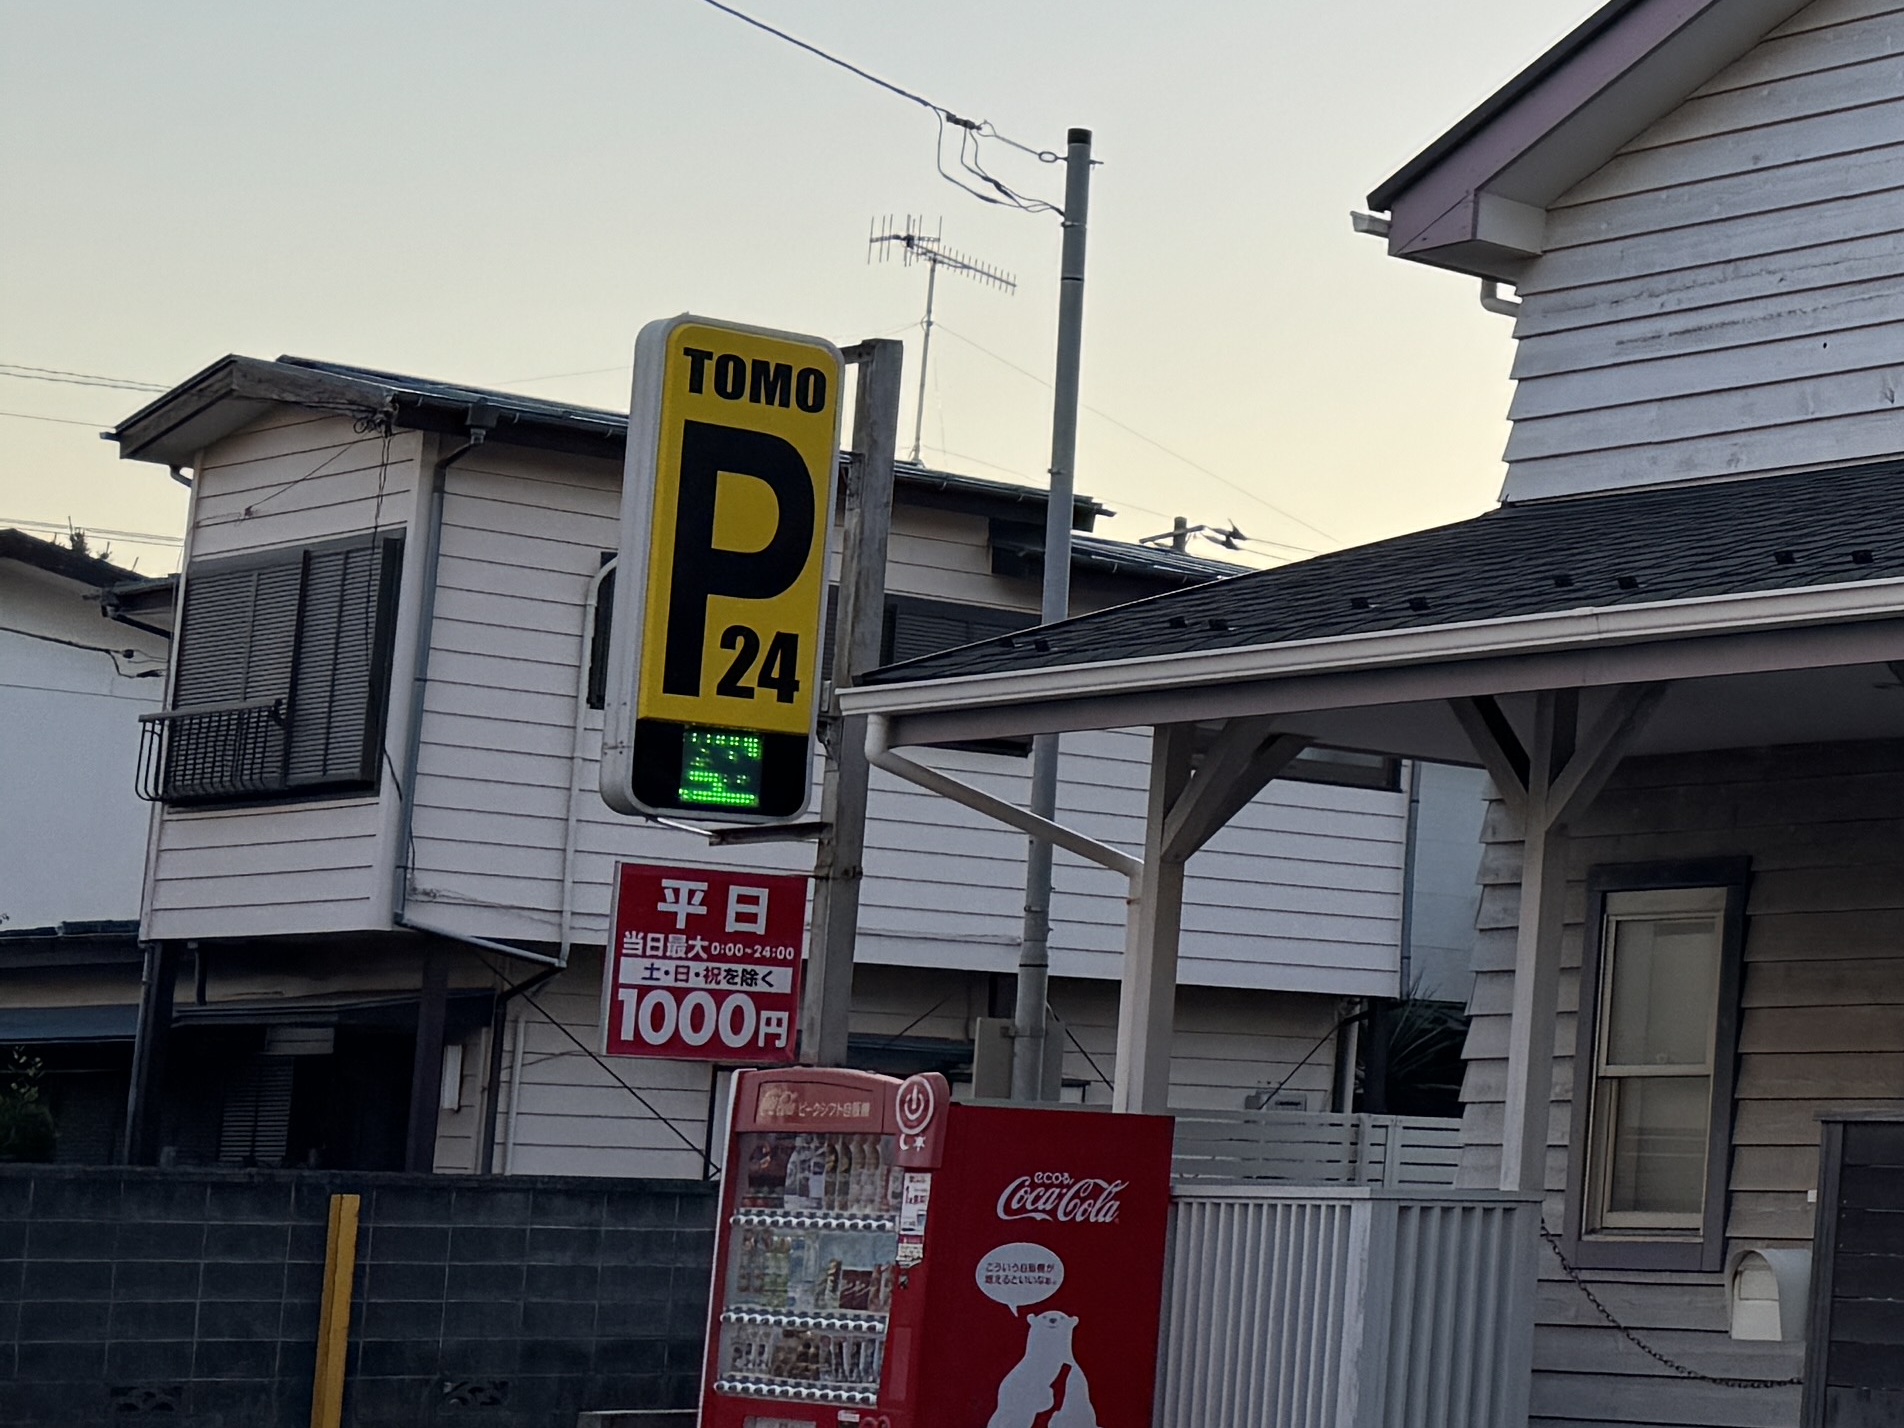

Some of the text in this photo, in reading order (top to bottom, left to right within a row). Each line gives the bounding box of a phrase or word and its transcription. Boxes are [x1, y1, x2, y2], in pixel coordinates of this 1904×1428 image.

[683, 347, 827, 414] TOMO
[662, 419, 815, 697] P
[716, 624, 800, 704] 24
[657, 878, 769, 935] 平日
[622, 930, 710, 959] 当日最大
[618, 988, 789, 1048] 1000円
[996, 1176, 1130, 1223] Coca-Cola
